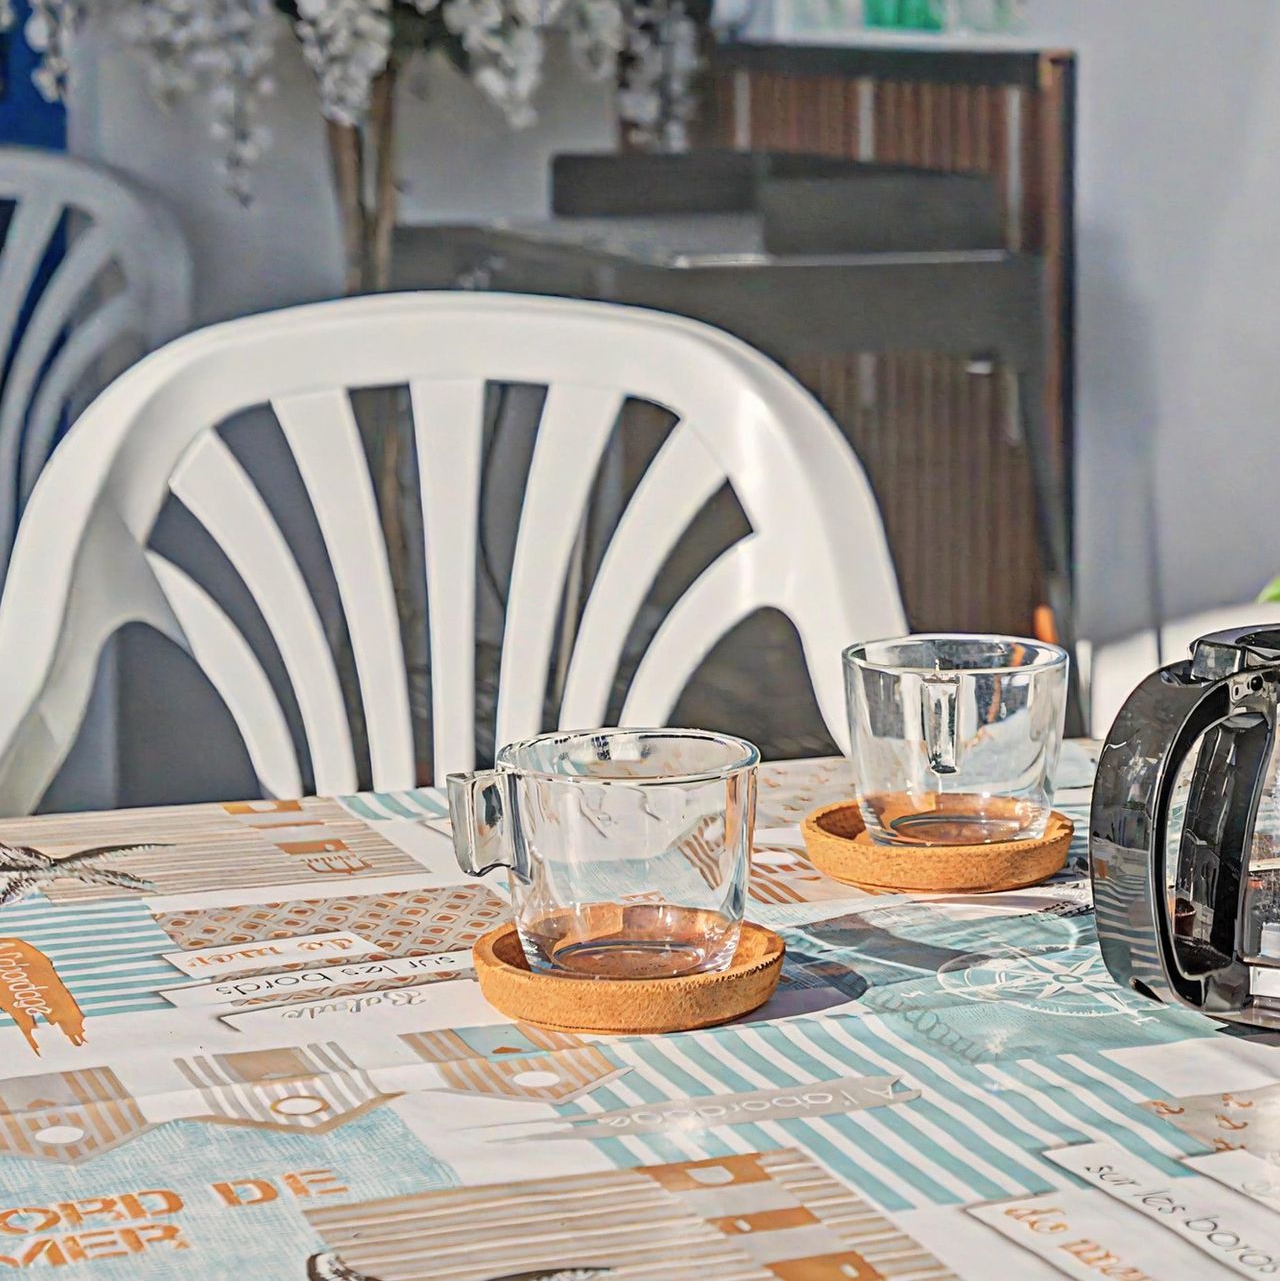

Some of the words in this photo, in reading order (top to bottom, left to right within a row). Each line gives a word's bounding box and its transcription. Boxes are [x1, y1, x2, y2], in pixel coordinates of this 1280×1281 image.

[216, 971, 334, 996] bords
[211, 1169, 349, 1207] DE
[1085, 1164, 1142, 1187] sur
[1132, 1188, 1187, 1216] les
